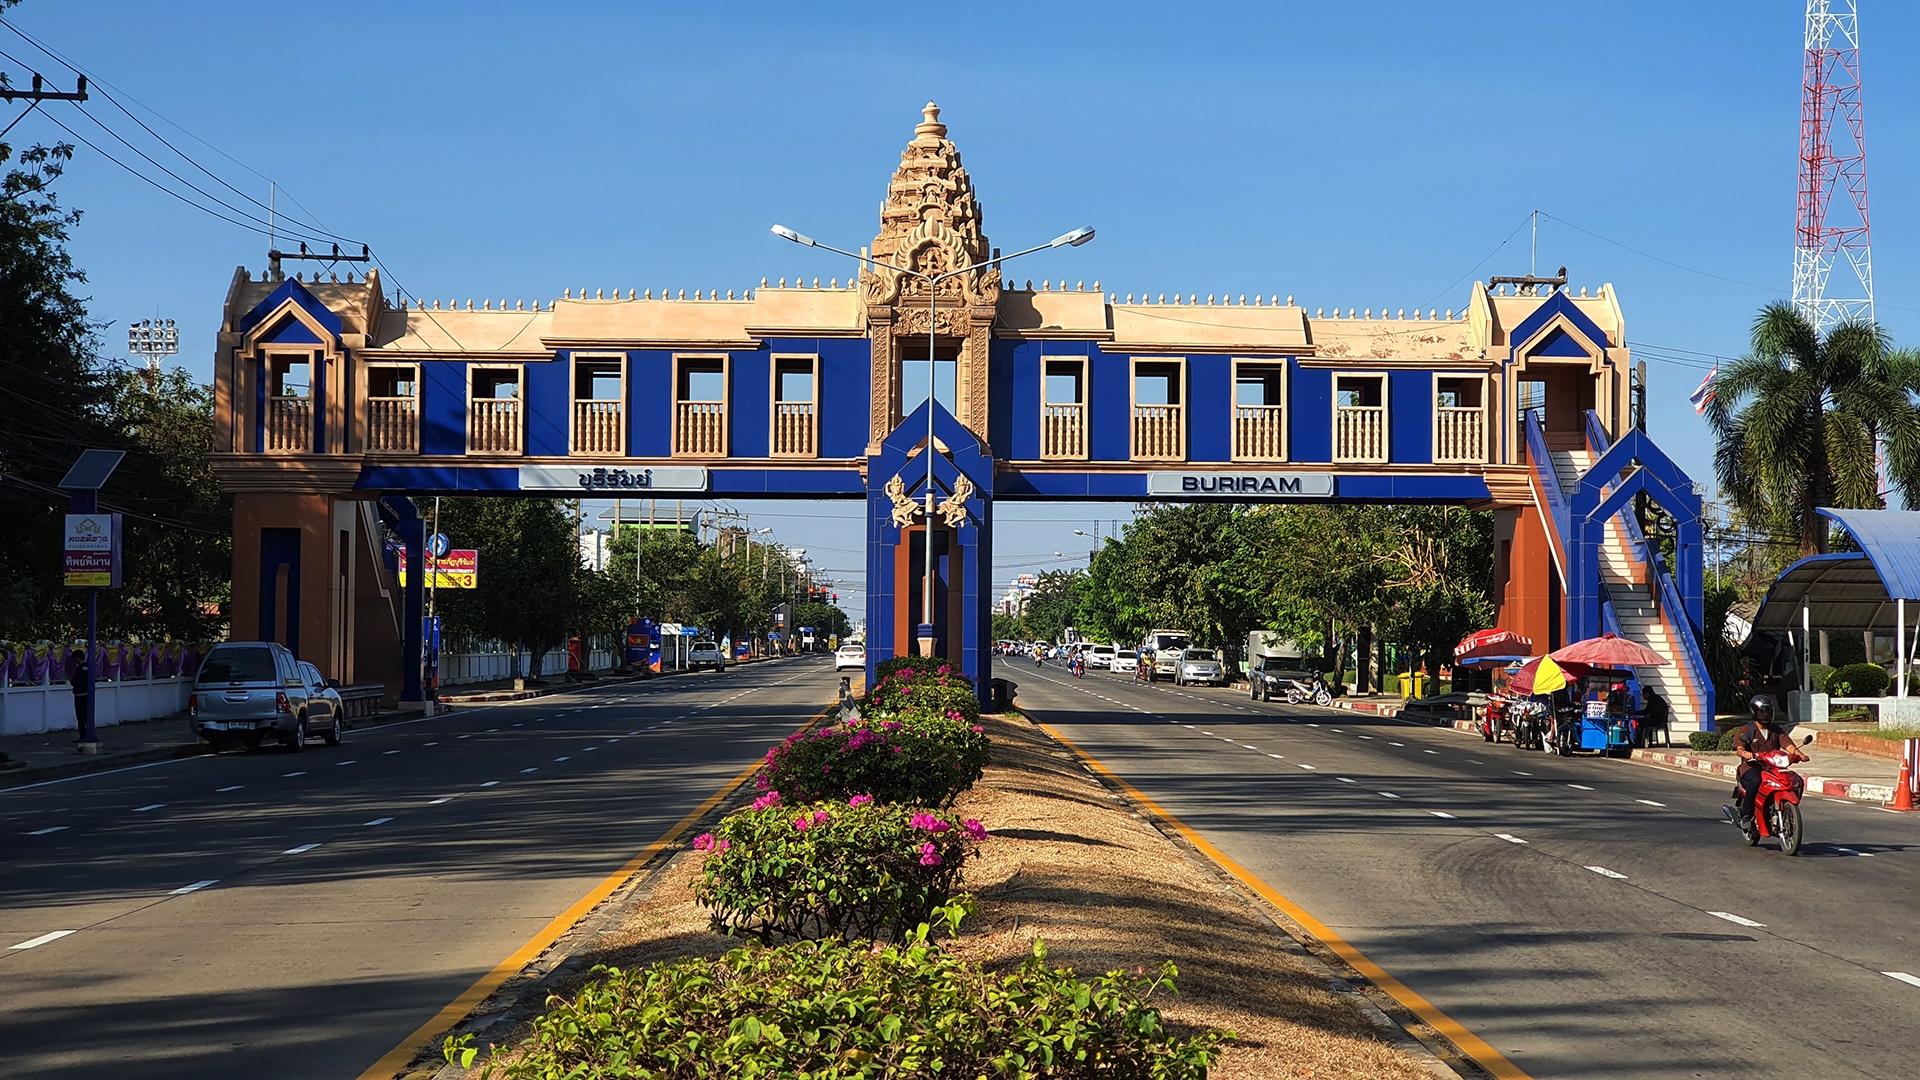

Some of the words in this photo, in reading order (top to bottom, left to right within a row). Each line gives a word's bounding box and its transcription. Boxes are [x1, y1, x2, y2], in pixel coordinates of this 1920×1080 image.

[578, 467, 654, 491] บุรีรัมย์
[1182, 475, 1303, 493] BURIRAM
[65, 555, 110, 566] ทิพย์พิมาน
[463, 575, 473, 587] 3
